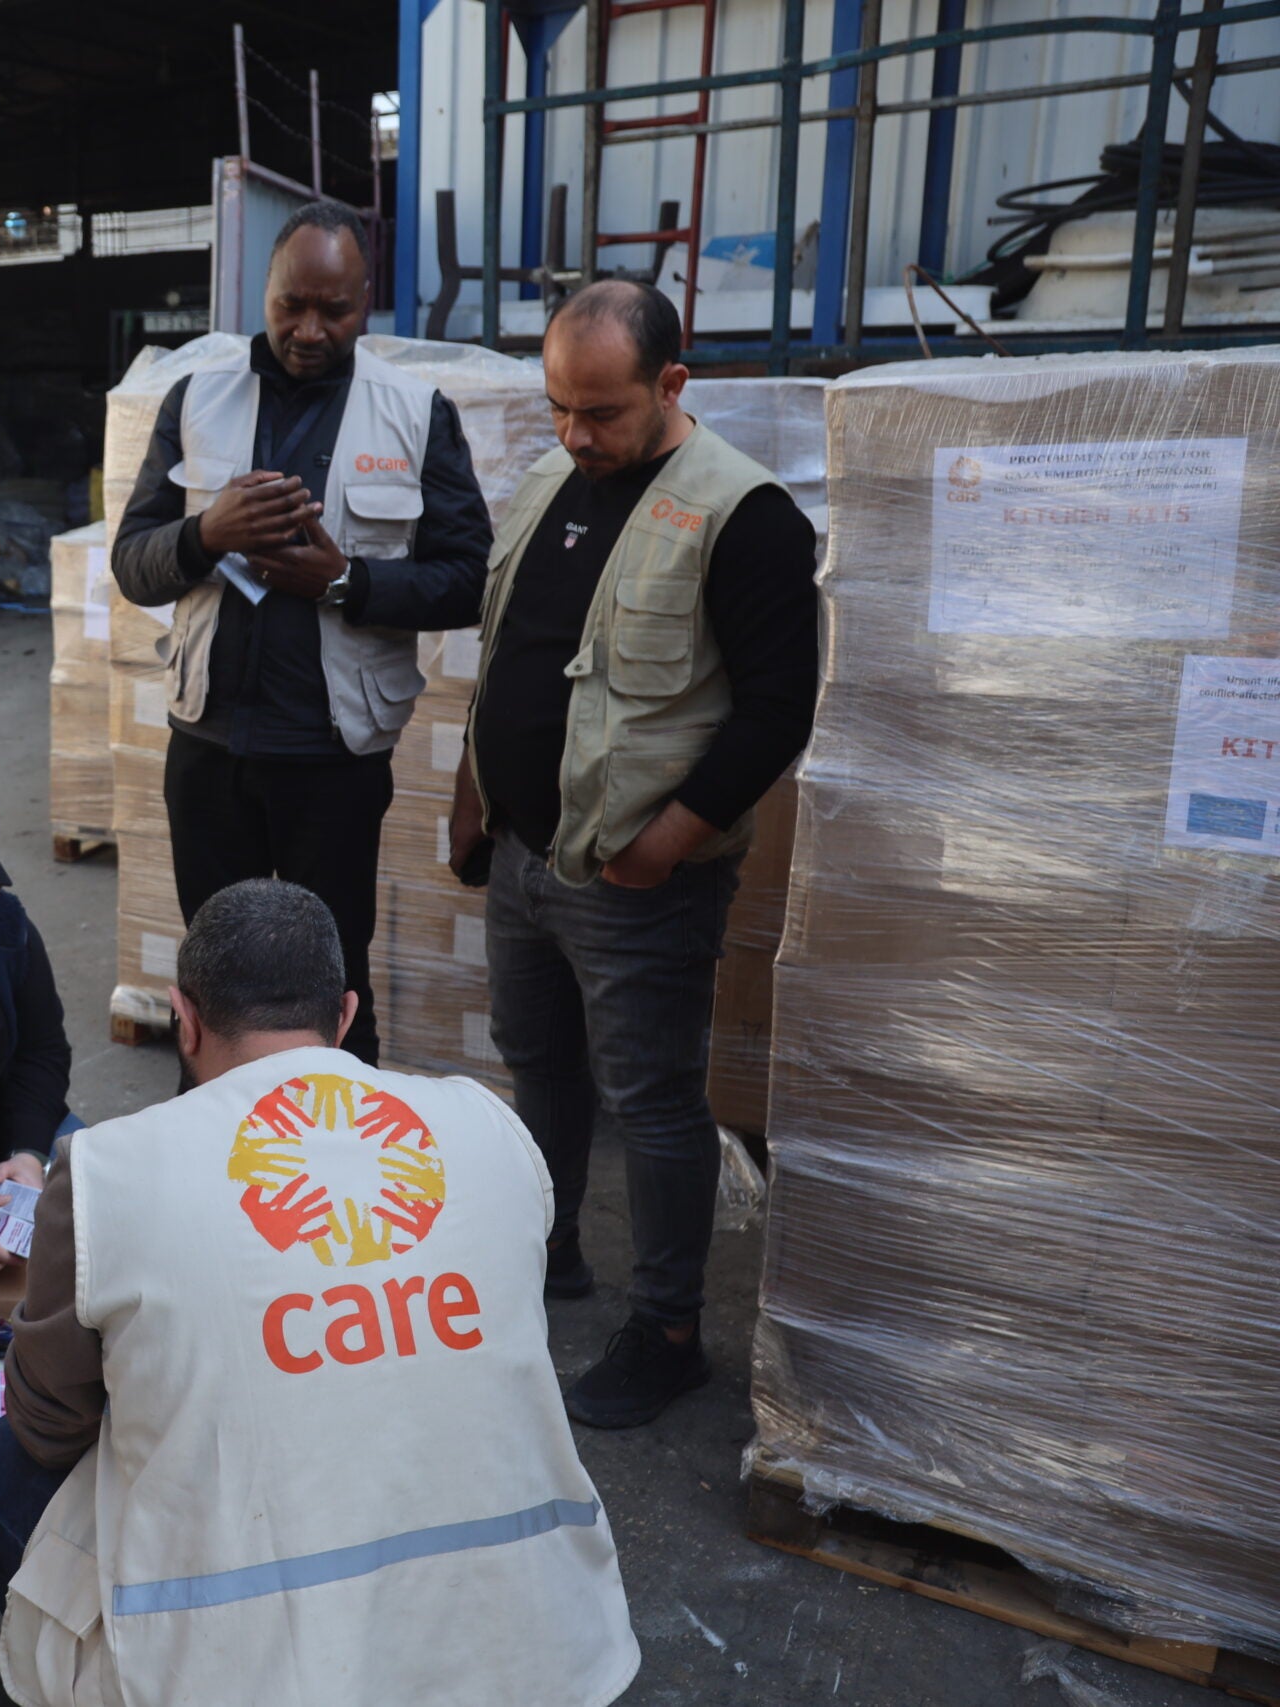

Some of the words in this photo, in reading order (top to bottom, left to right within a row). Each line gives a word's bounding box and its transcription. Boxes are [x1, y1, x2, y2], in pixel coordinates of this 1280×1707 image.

[376, 457, 409, 472] care
[947, 489, 982, 503] care
[565, 522, 589, 535] GANT
[670, 511, 703, 532] care
[1221, 736, 1280, 760] KIT
[262, 1272, 483, 1374] care
